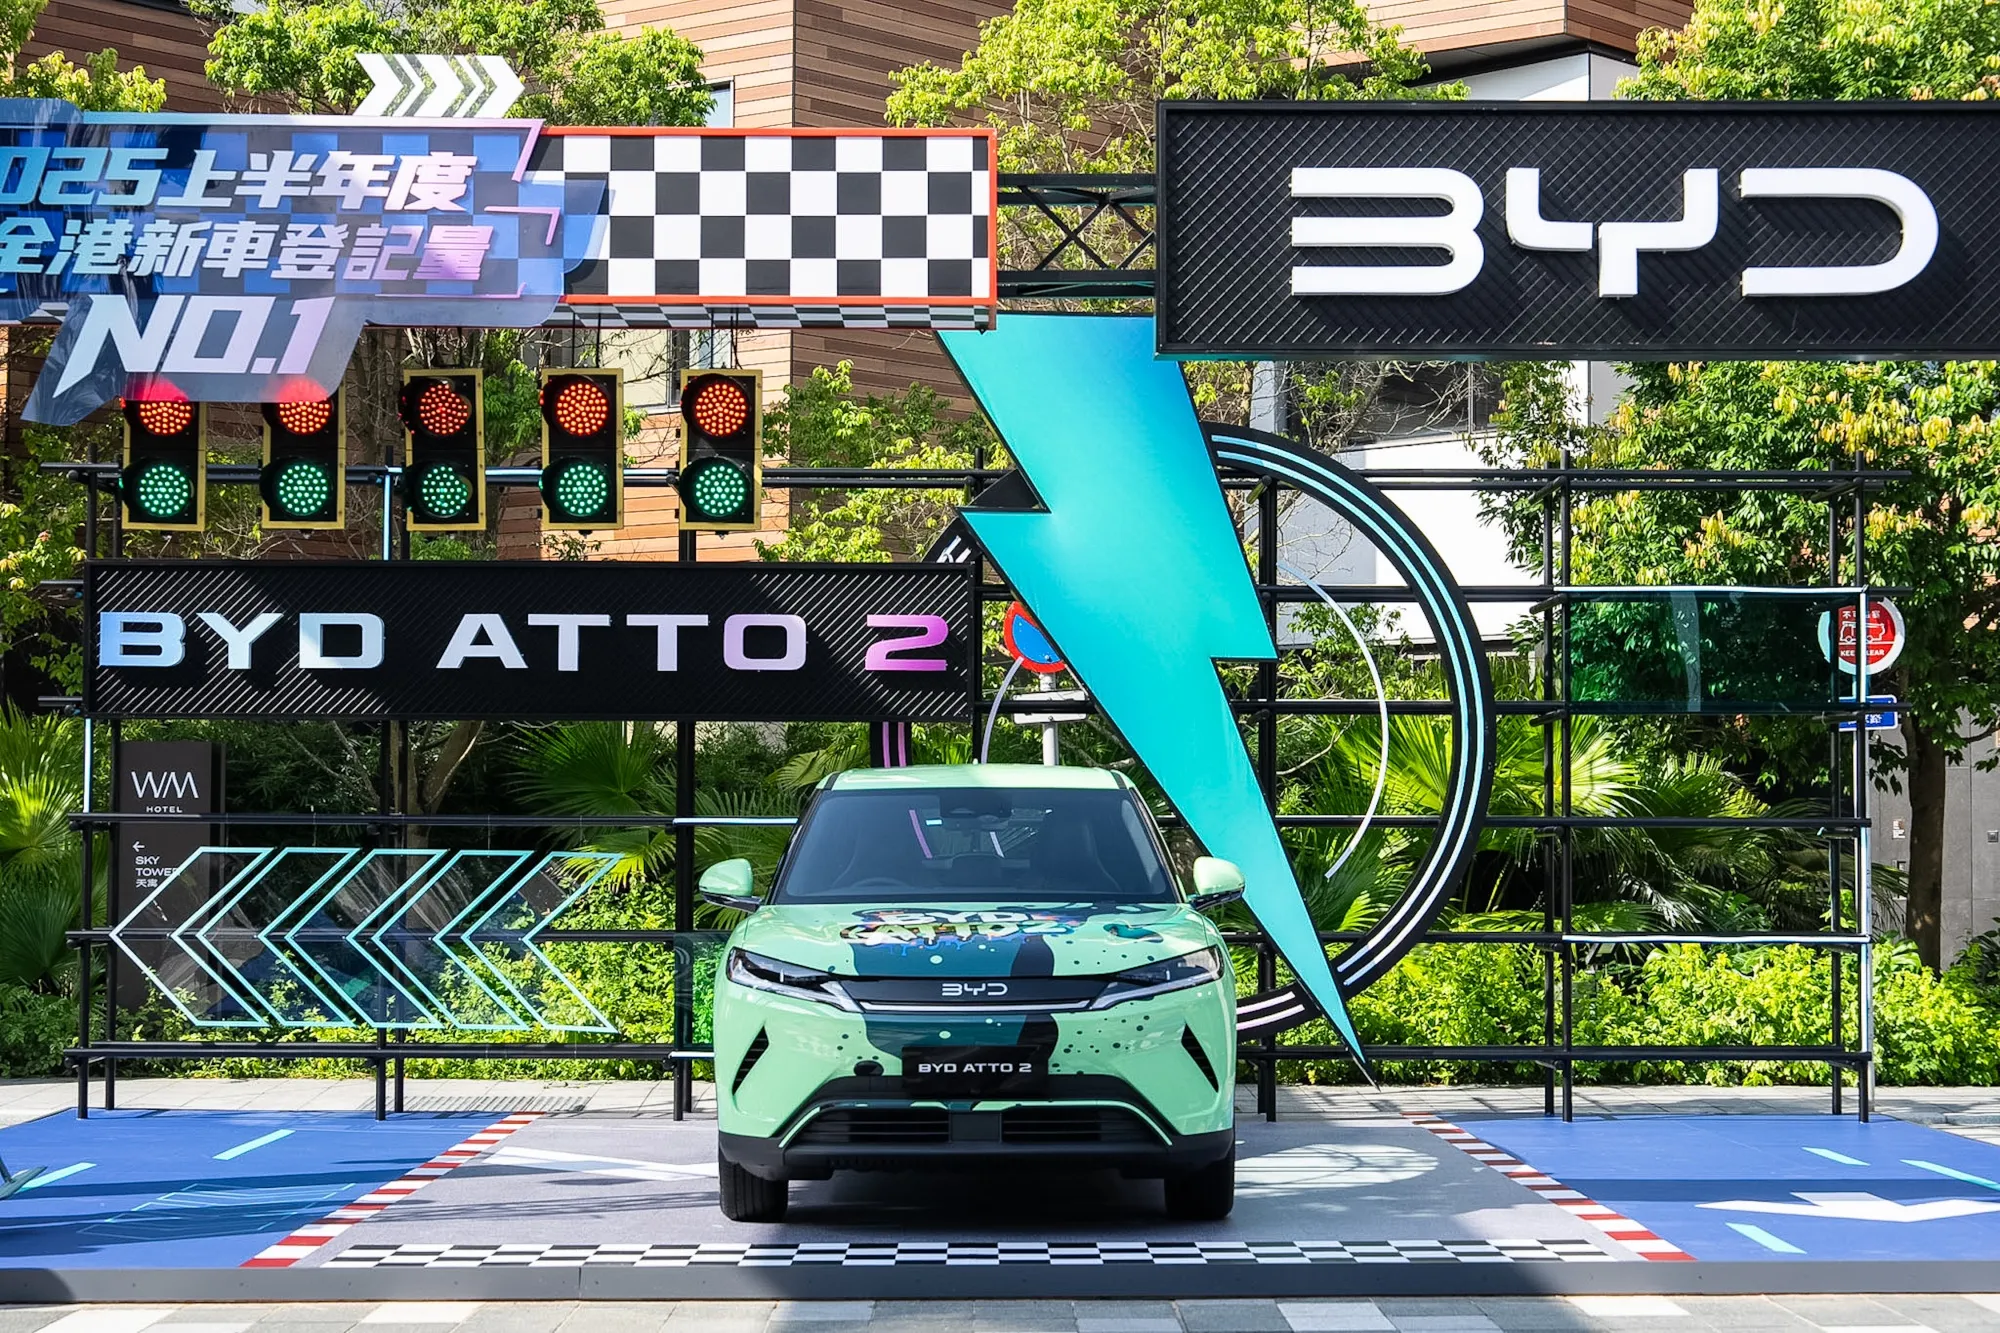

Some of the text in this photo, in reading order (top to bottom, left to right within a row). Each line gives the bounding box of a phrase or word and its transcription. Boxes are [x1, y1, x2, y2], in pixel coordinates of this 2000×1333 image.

[1291, 167, 1939, 299] BYD
[53, 294, 336, 398] NO.1
[98, 611, 948, 672] BYD ATTO 2
[1840, 649, 1857, 657] KEE
[146, 806, 183, 814] HOTEL
[135, 856, 160, 865] SKY
[880, 911, 1029, 925] BYD
[941, 982, 1008, 996] BYD
[918, 1062, 1033, 1073] BYD ATTO 2
